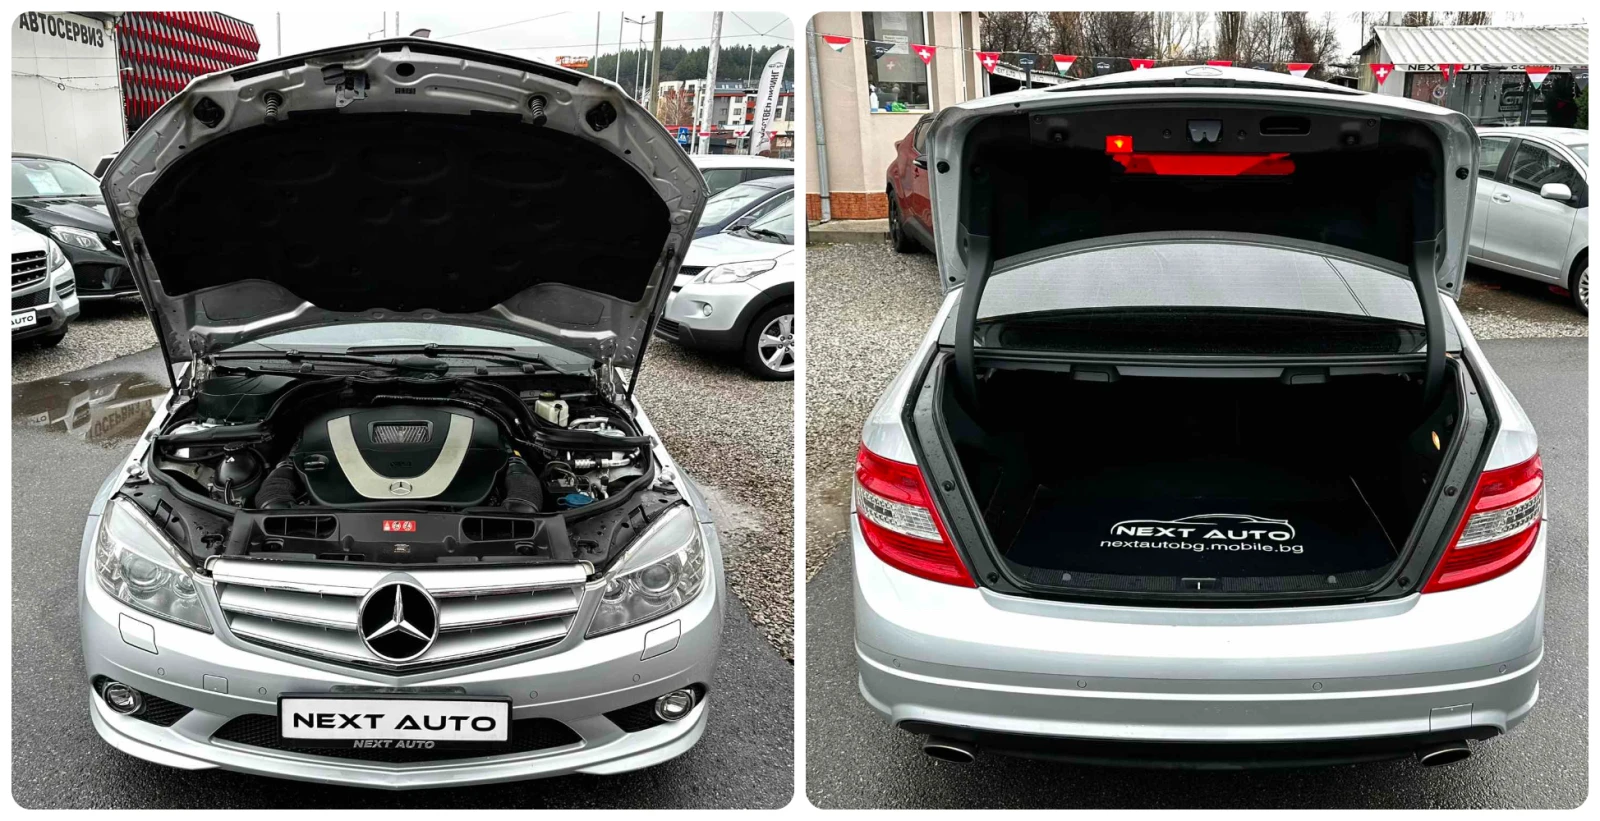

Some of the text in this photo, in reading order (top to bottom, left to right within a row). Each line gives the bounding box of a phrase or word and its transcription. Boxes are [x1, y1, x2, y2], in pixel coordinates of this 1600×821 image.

[19, 11, 104, 48] АВТОСЕРВИЗ
[1116, 526, 1290, 541] NEXT AUTO
[1100, 540, 1304, 554] nextautobg.mobile.bg
[293, 713, 496, 732] NEXT AUTO
[353, 740, 435, 749] NEXT AUTO
